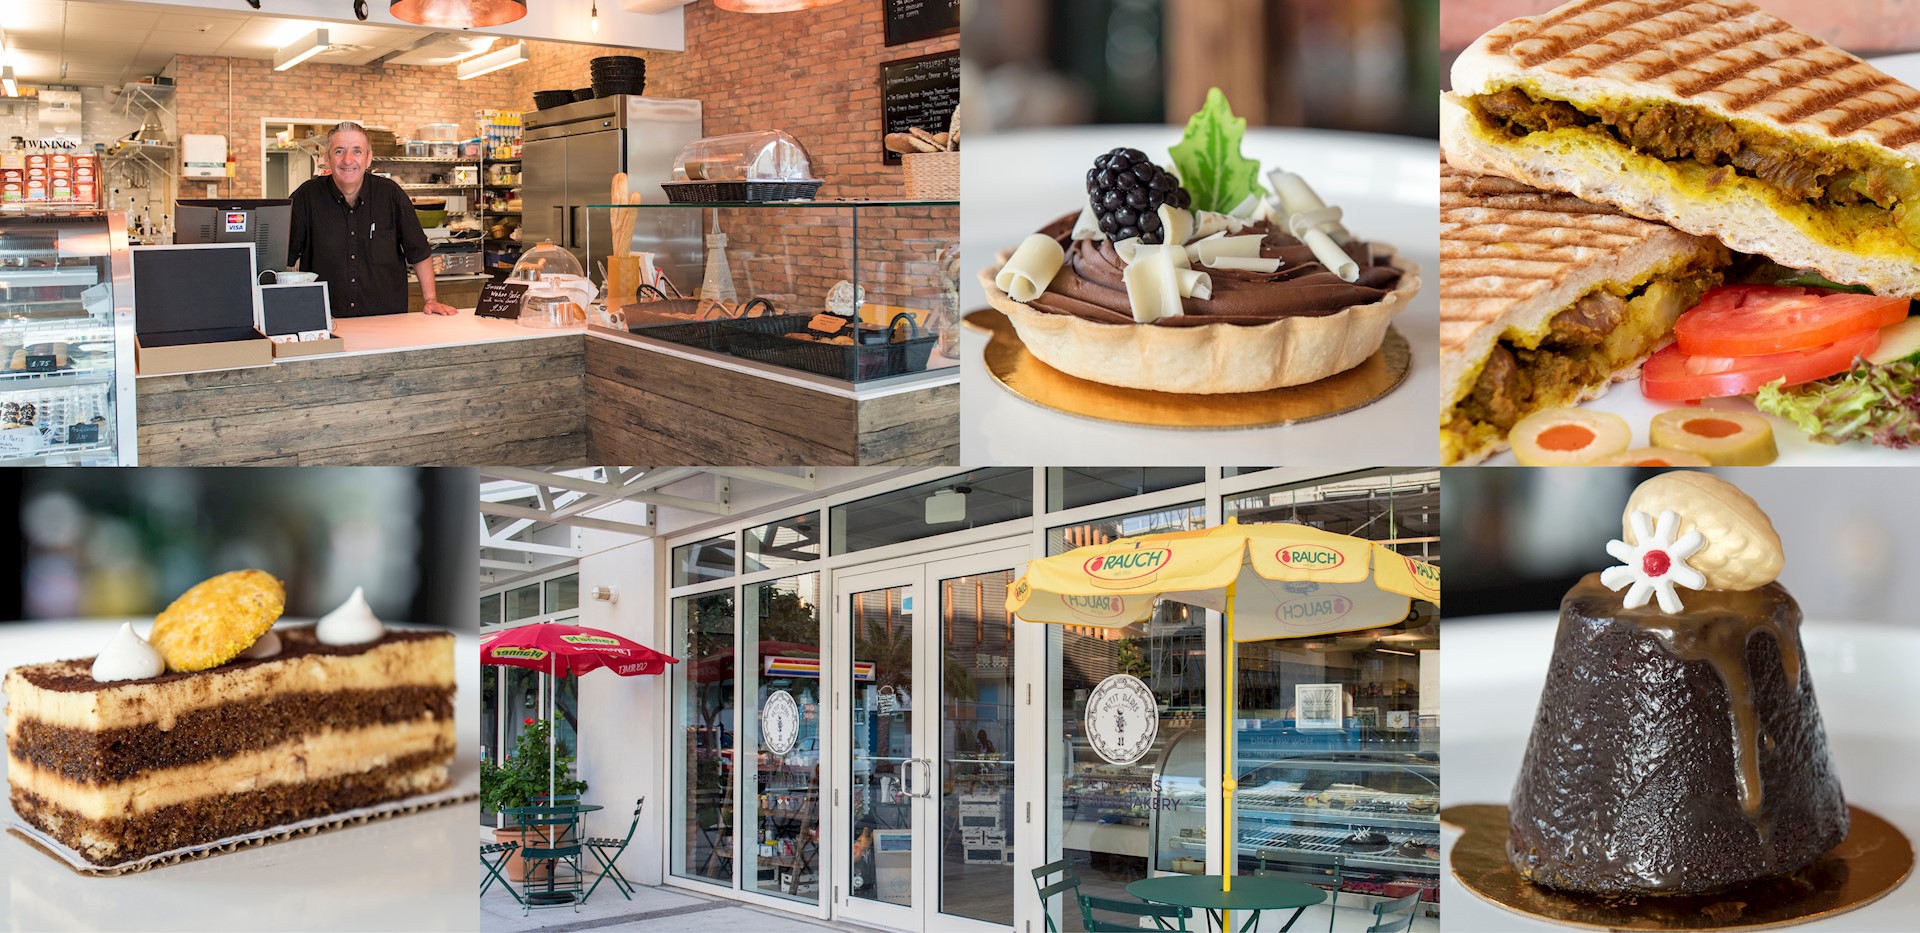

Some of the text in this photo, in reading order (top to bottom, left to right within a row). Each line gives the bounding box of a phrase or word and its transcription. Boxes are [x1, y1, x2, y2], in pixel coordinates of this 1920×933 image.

[1103, 550, 1164, 570] RAUCH
[1292, 551, 1337, 565] RAUCH
[1412, 559, 1440, 582] RAUC
[1103, 692, 1120, 712] PETIT
[1122, 692, 1140, 712] PARIS
[1125, 796, 1181, 811] BAKERY
